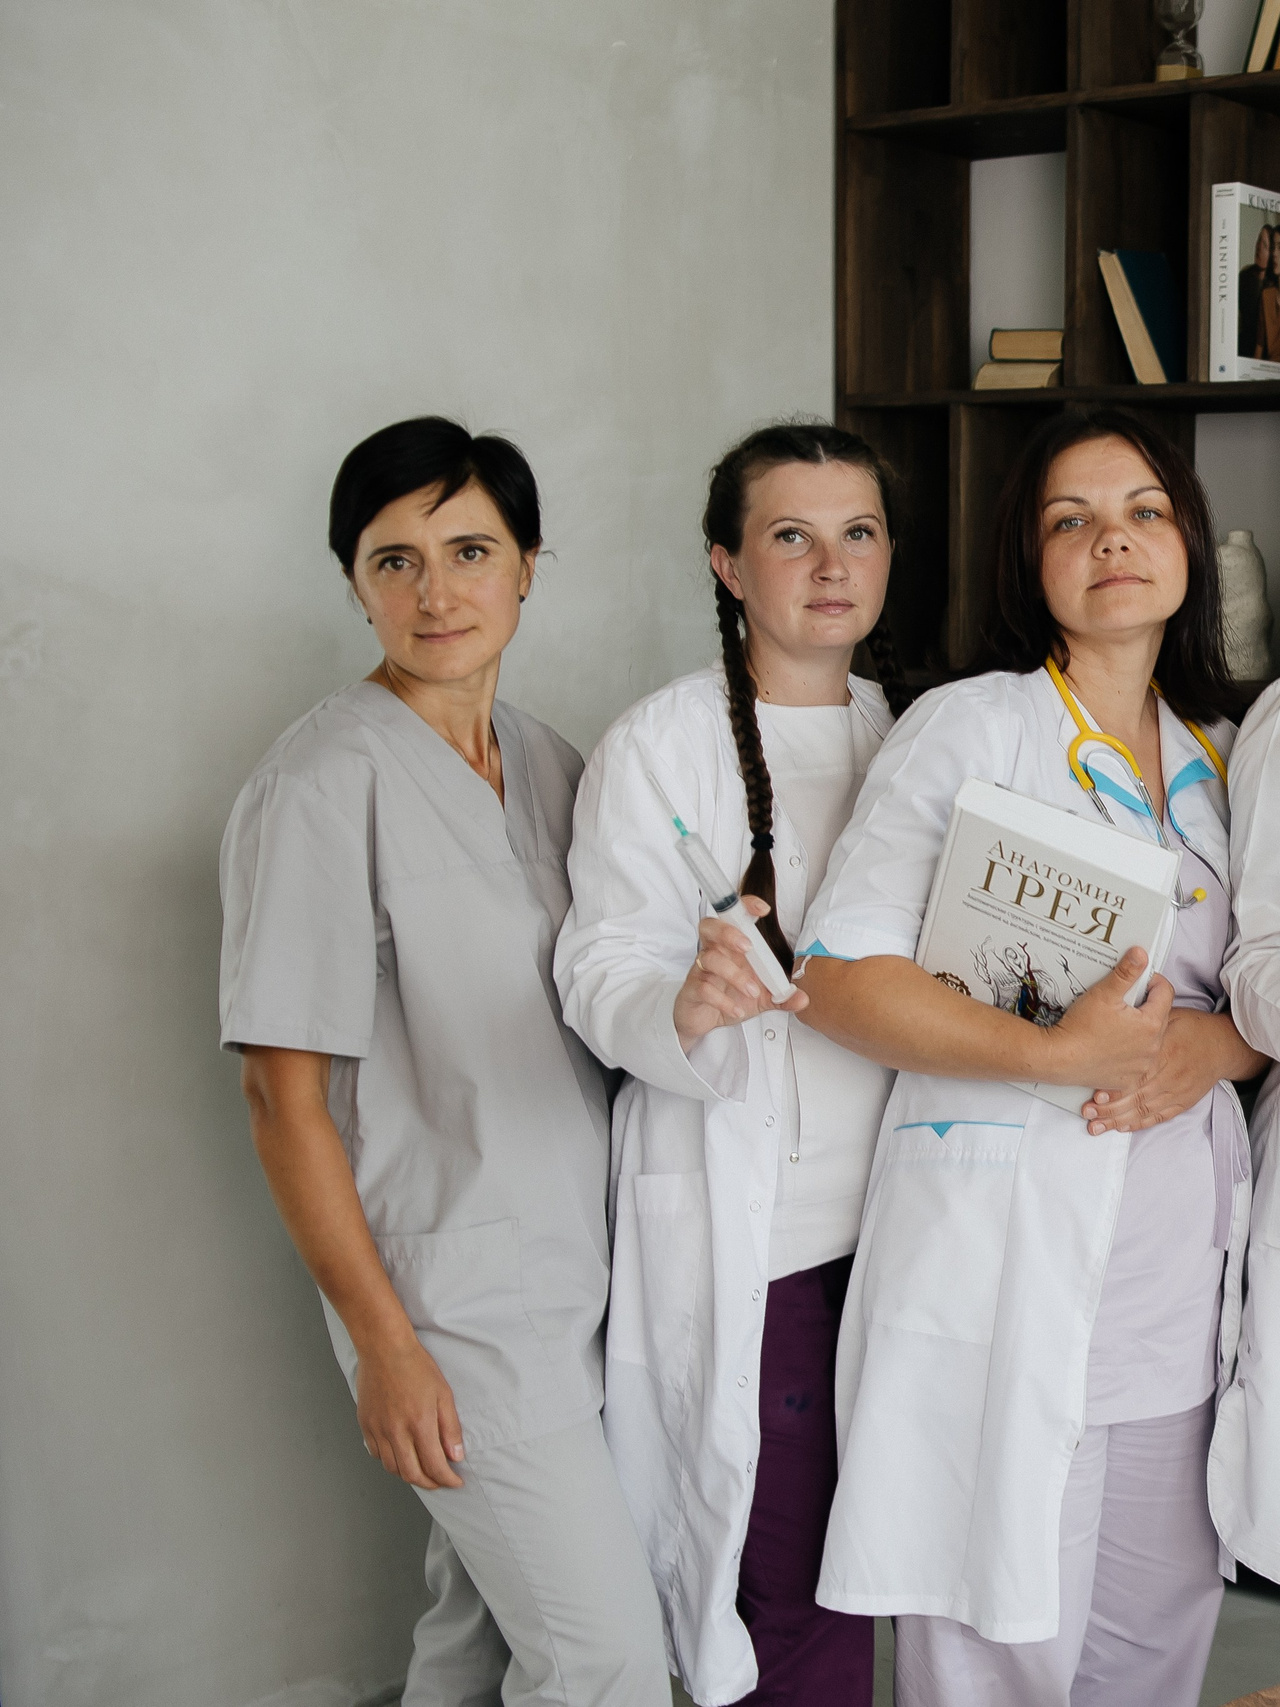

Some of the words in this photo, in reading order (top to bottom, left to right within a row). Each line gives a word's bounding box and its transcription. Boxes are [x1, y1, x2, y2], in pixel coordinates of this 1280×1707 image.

[1219, 235, 1228, 302] KINFOLK
[978, 857, 1122, 946] ГРЕЯ
[987, 840, 1126, 911] АНАТОМИЯ
